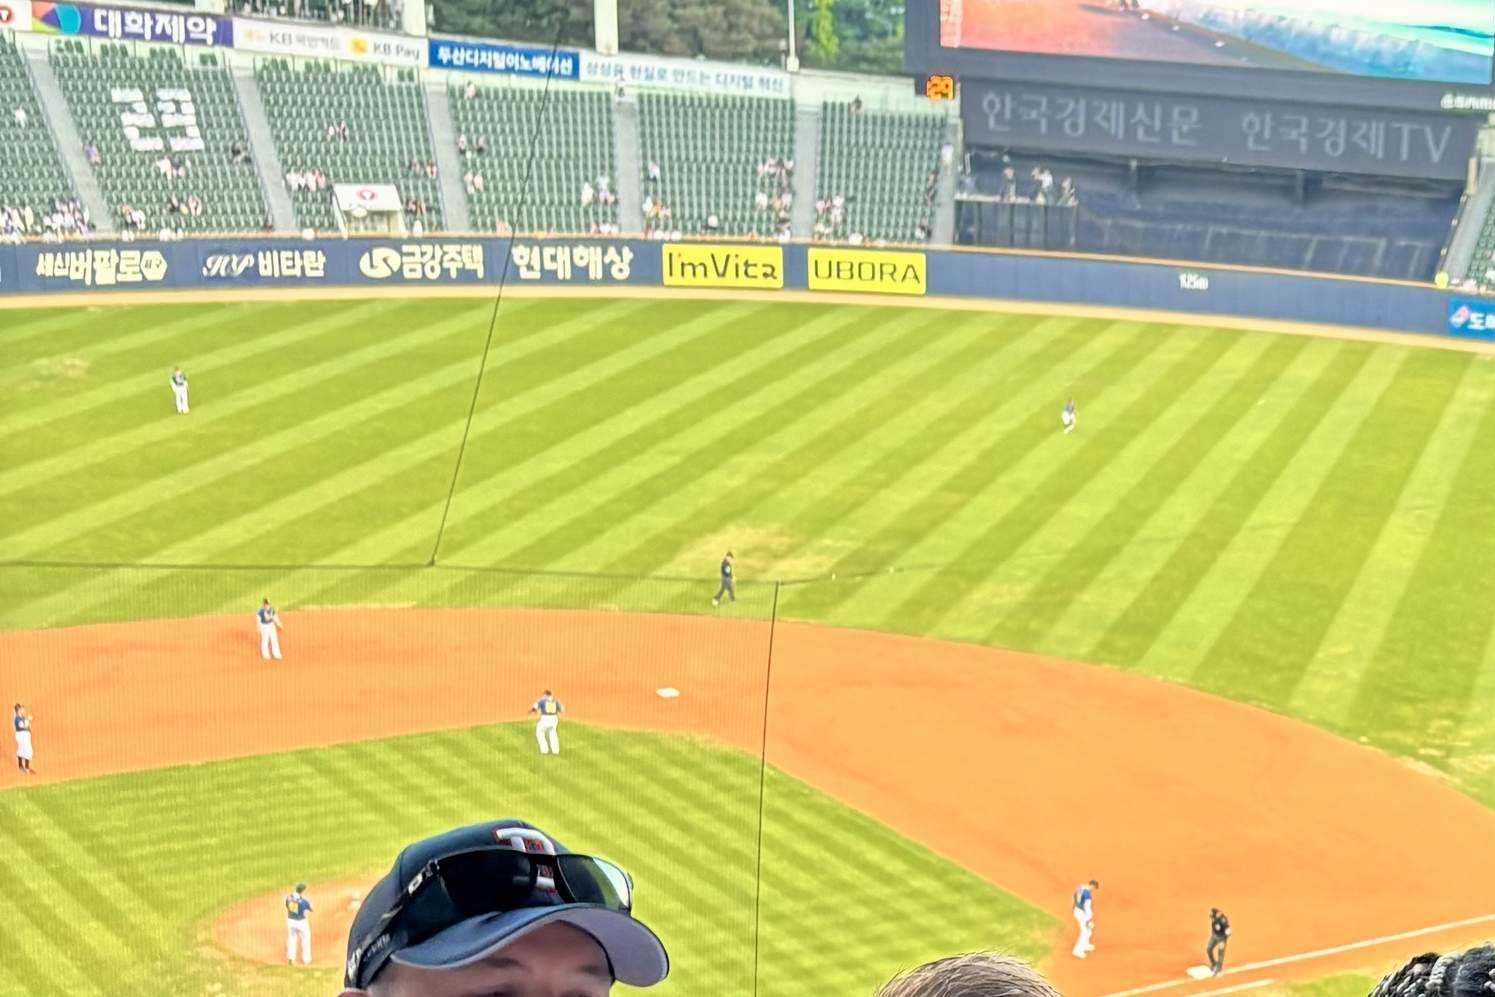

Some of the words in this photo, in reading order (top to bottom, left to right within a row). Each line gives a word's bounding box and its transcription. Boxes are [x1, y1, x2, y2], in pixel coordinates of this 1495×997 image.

[93, 9, 217, 45] 대화제약
[982, 90, 1203, 145] 한국경제신문
[1241, 110, 1452, 163] 한국경제TV
[258, 249, 326, 277] 비타란
[401, 245, 484, 279] 금강주택
[511, 244, 634, 280] 현대해상
[814, 258, 921, 284] UBORA
